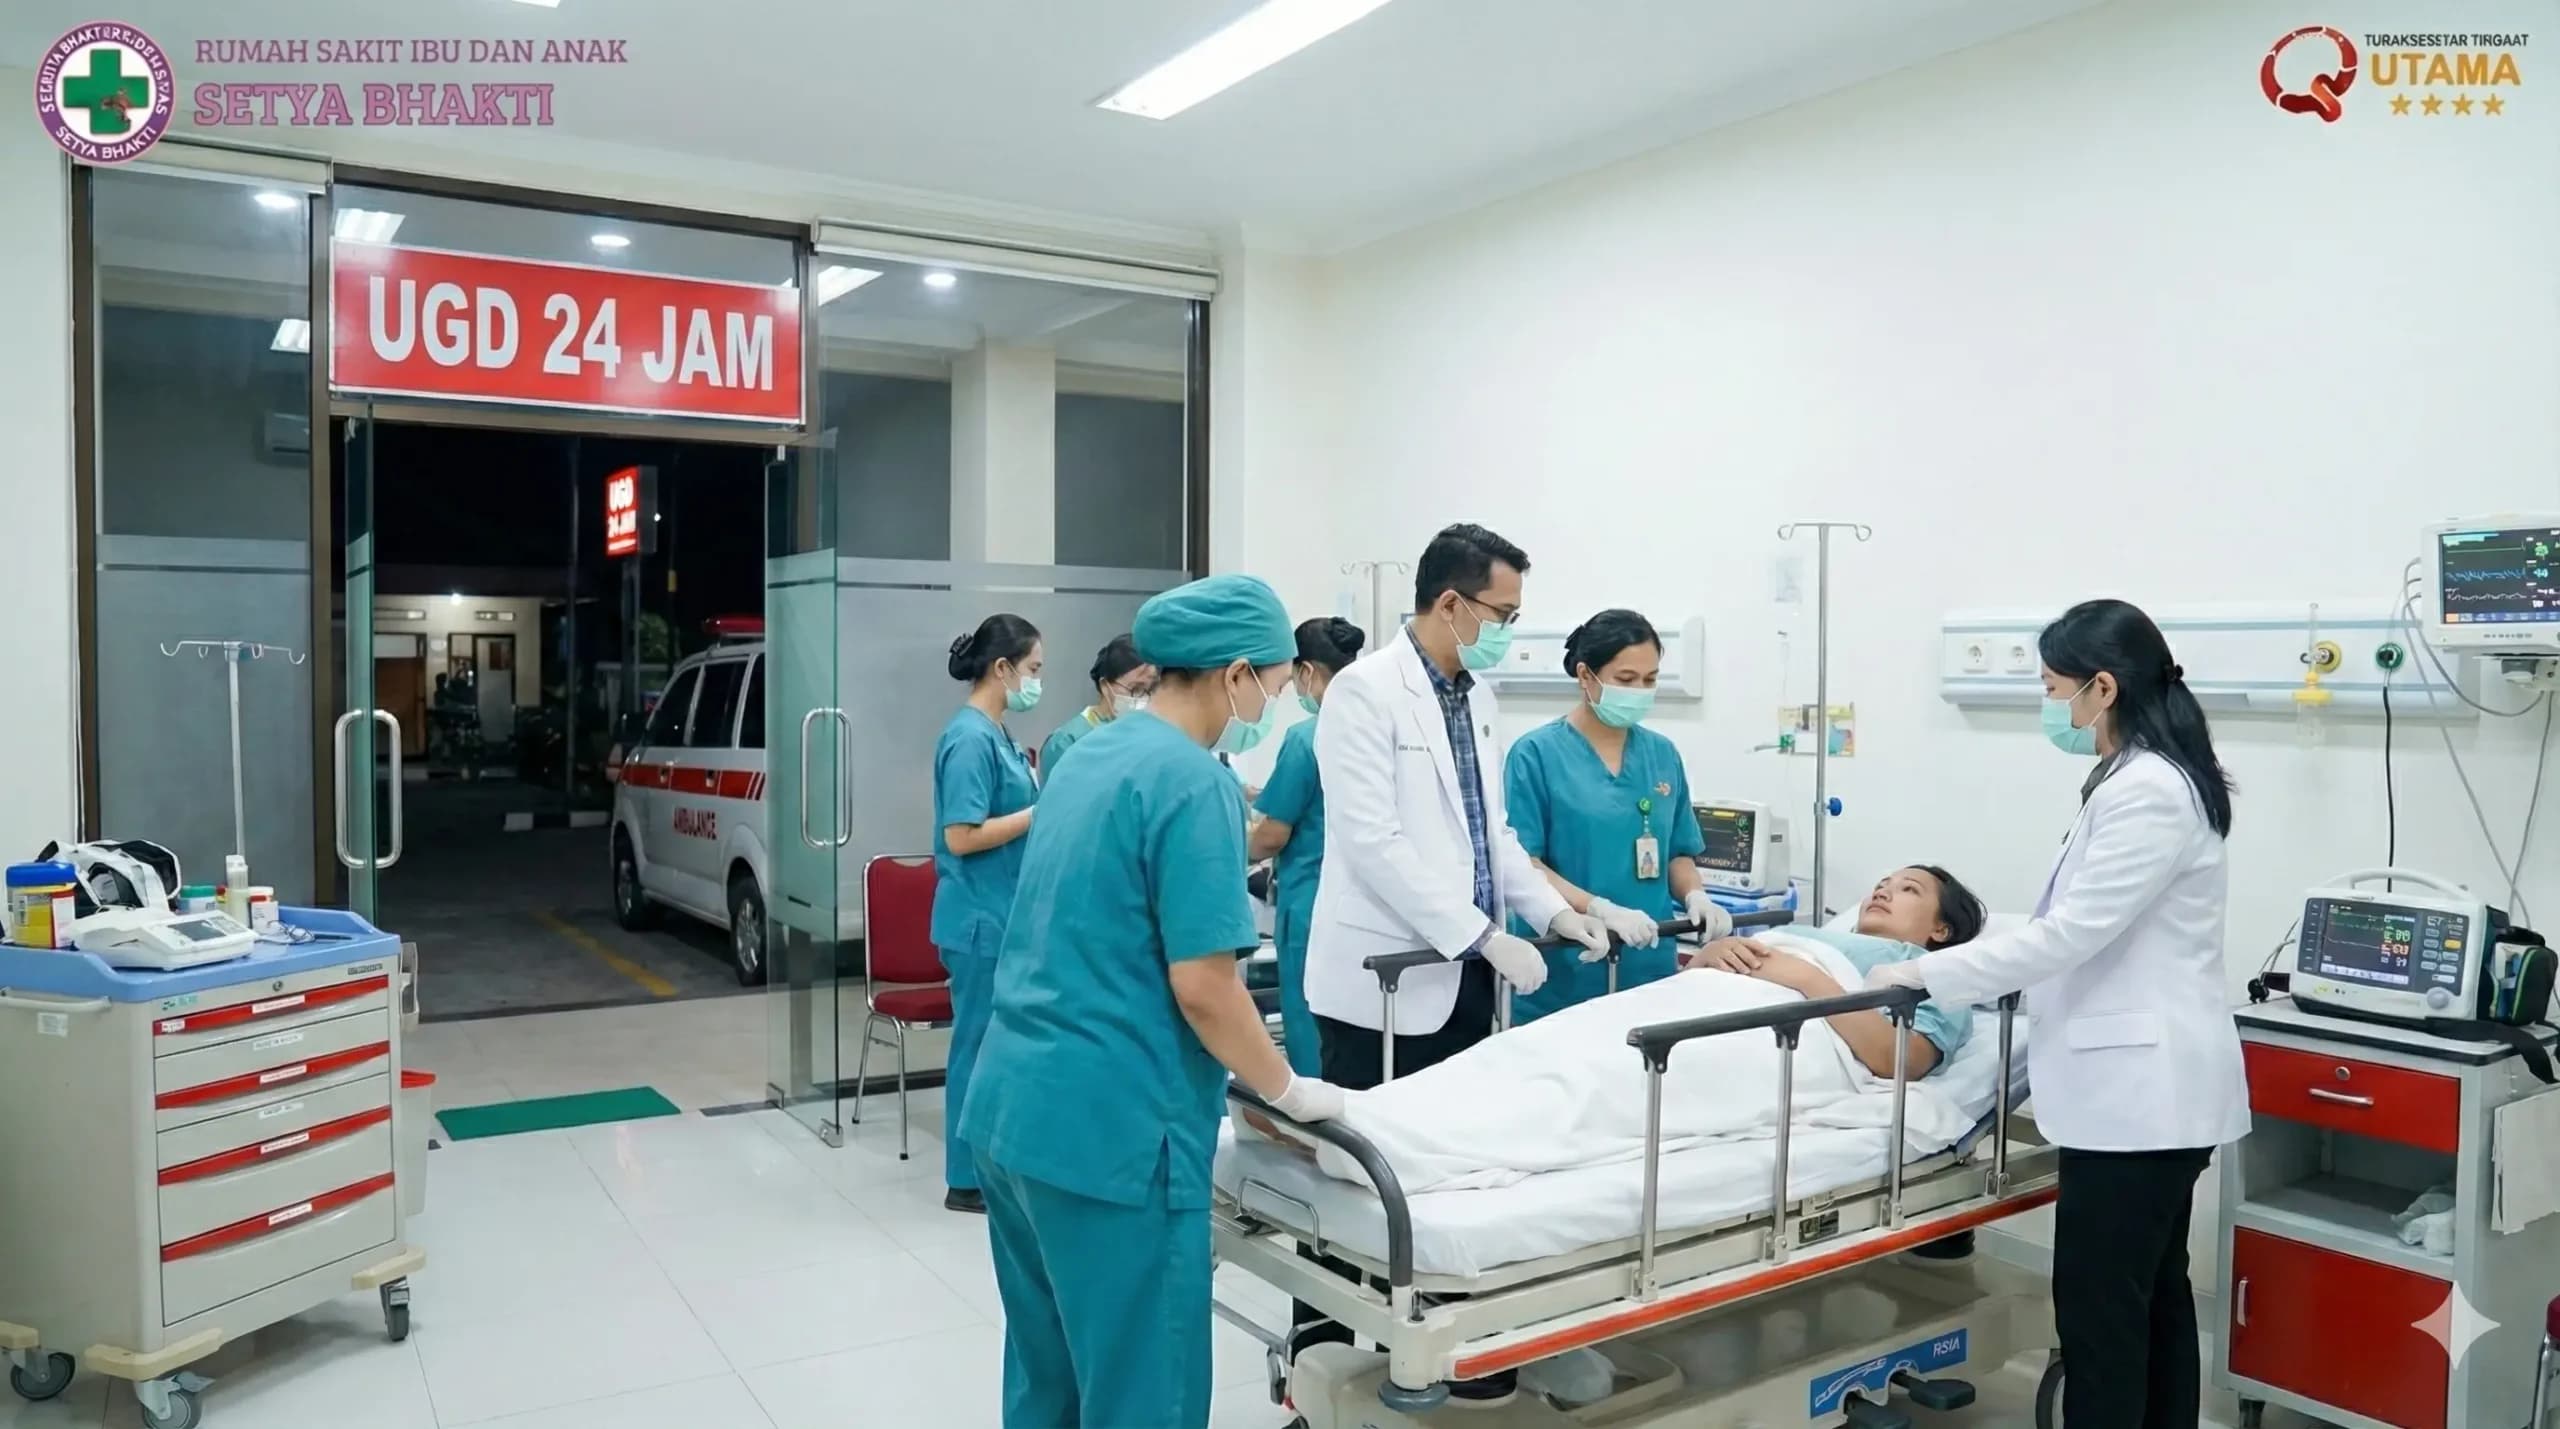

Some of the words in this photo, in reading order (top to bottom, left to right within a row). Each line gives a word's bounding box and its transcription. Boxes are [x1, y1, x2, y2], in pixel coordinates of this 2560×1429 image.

[369, 275, 520, 369] UGD
[543, 293, 622, 379] 24
[641, 305, 774, 392] JAM
[1932, 1336, 1961, 1358] RSIA
